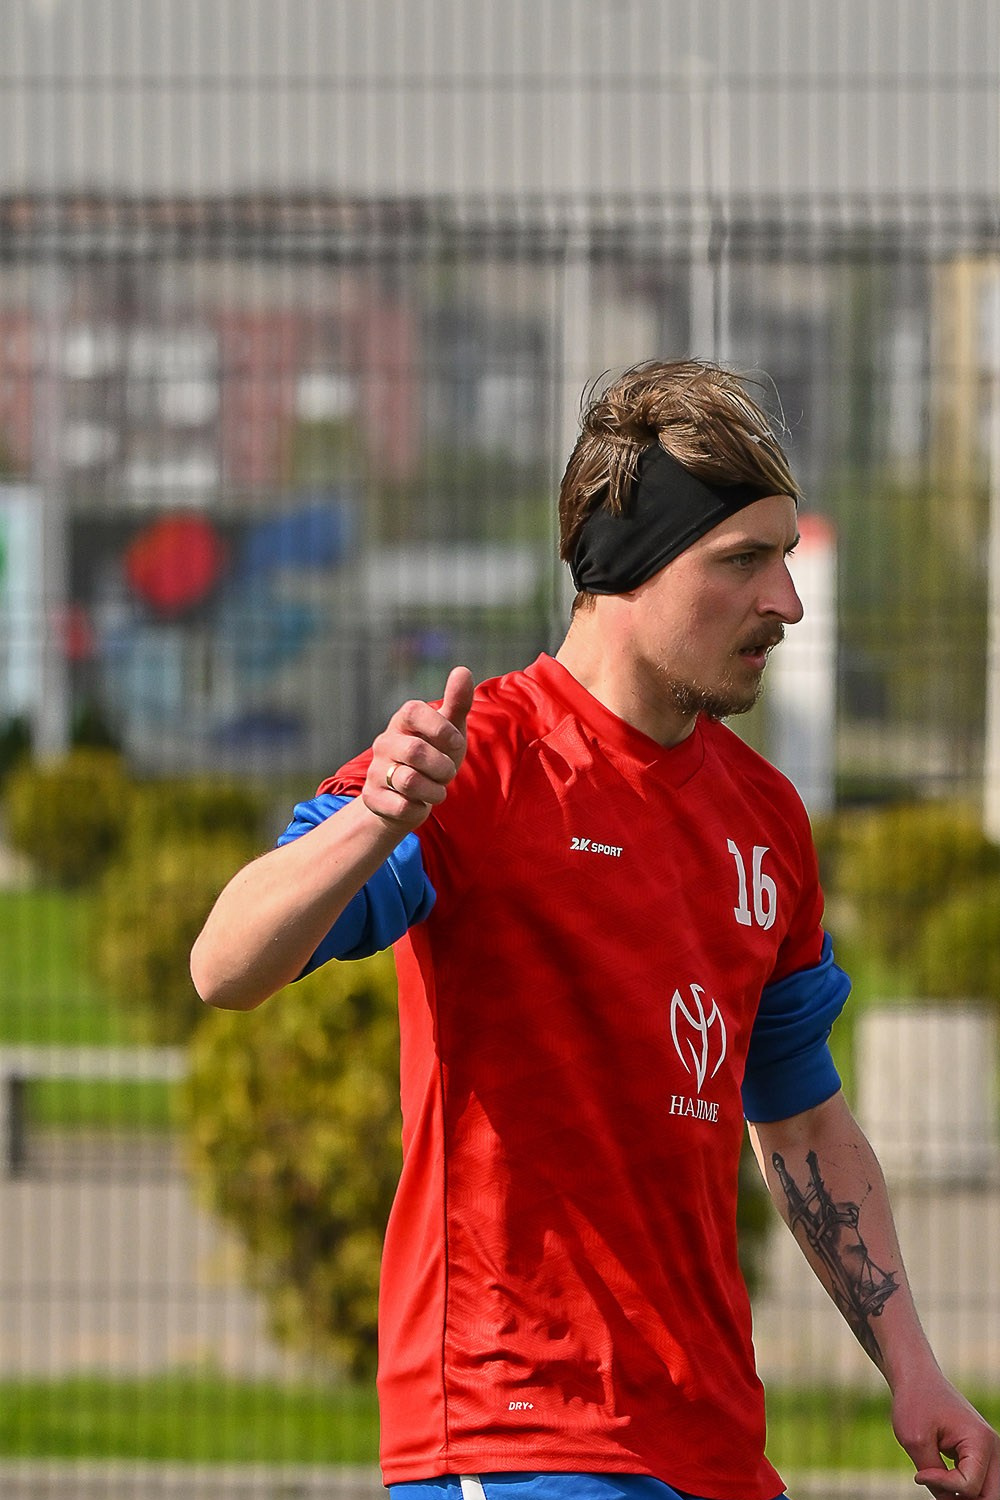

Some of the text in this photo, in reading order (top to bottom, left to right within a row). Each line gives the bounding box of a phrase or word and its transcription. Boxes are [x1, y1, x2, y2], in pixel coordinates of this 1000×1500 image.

[570, 837, 623, 858] 2K SPORT
[727, 838, 777, 931] 16
[668, 1094, 720, 1123] HAJIME
